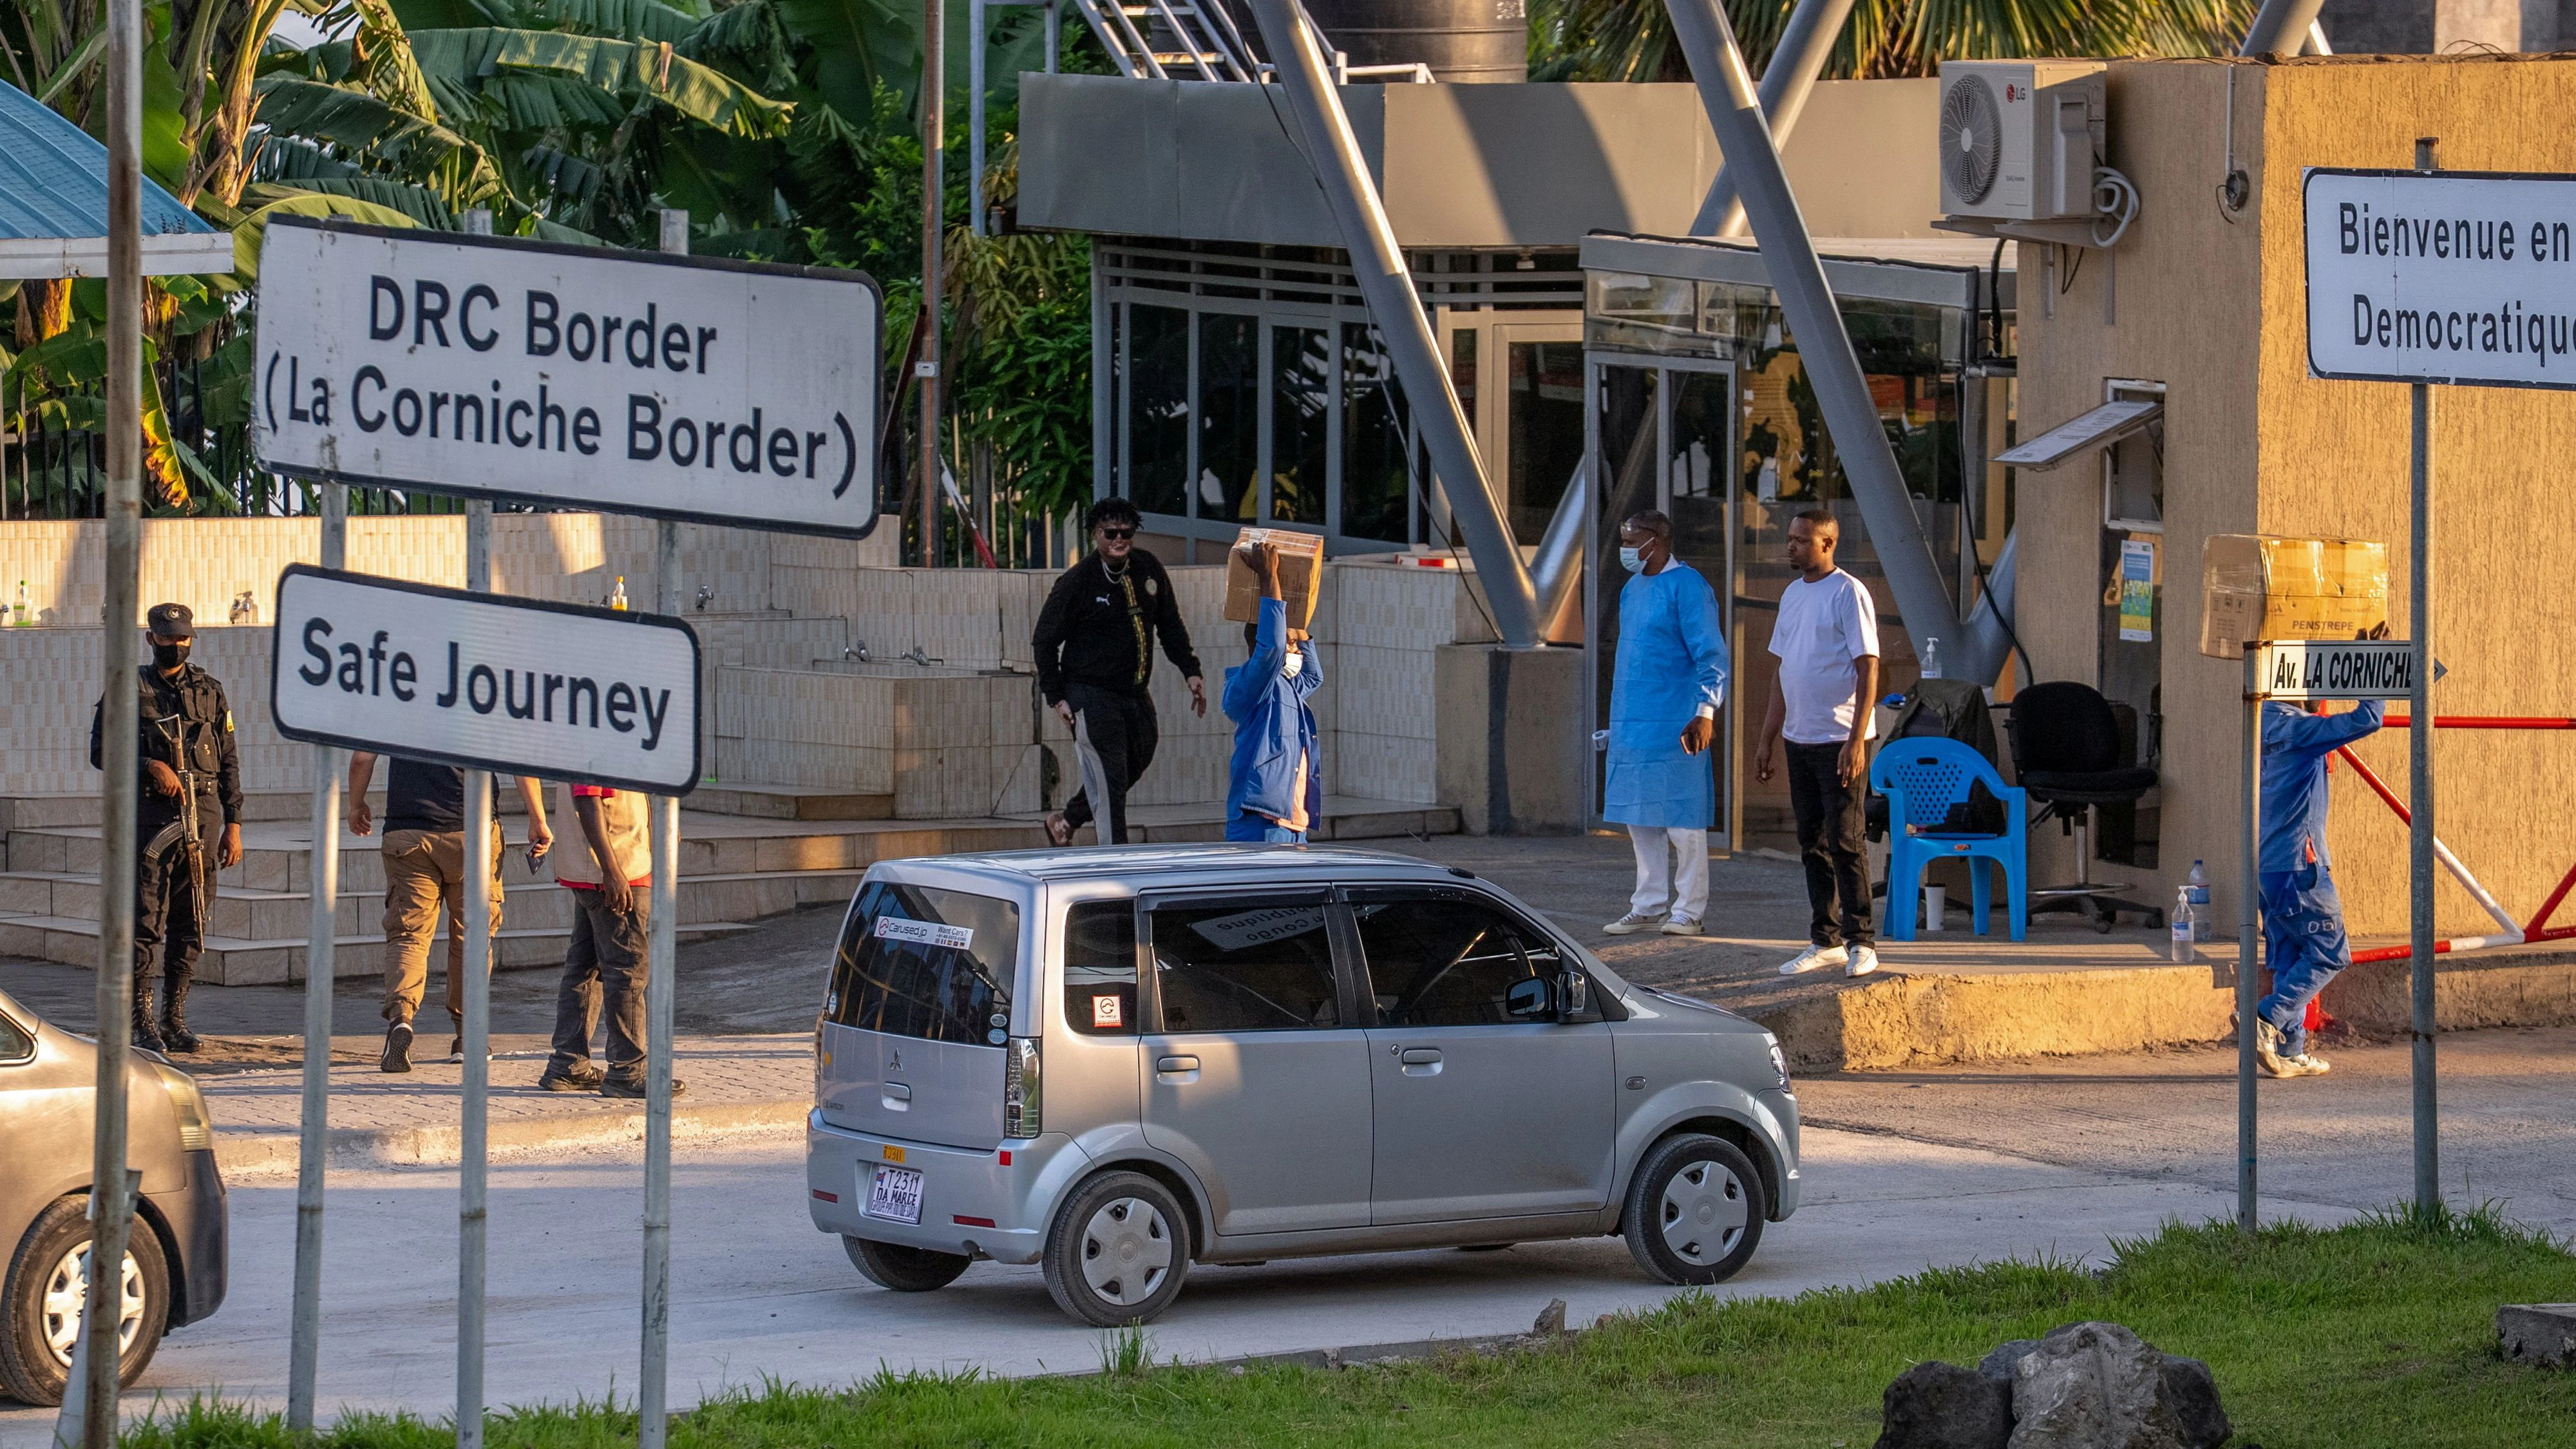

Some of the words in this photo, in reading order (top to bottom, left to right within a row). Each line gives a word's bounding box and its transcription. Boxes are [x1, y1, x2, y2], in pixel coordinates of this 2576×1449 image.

[2016, 87, 2025, 100] LG
[2340, 202, 2515, 261] Bienvenue
[2531, 221, 2570, 261] en
[370, 275, 500, 352] DRC
[526, 289, 716, 374] Border
[2354, 294, 2576, 368] Democratiqu
[265, 351, 330, 433] (La
[352, 365, 600, 455] Corniche
[628, 393, 857, 500] Border)
[298, 618, 417, 701] Safe
[436, 641, 670, 750] Journey
[2274, 653, 2297, 688] Av.
[2302, 652, 2323, 688] LA
[938, 925, 951, 934] Want
[952, 928, 969, 937] Cars?
[888, 1169, 920, 1193] T2311
